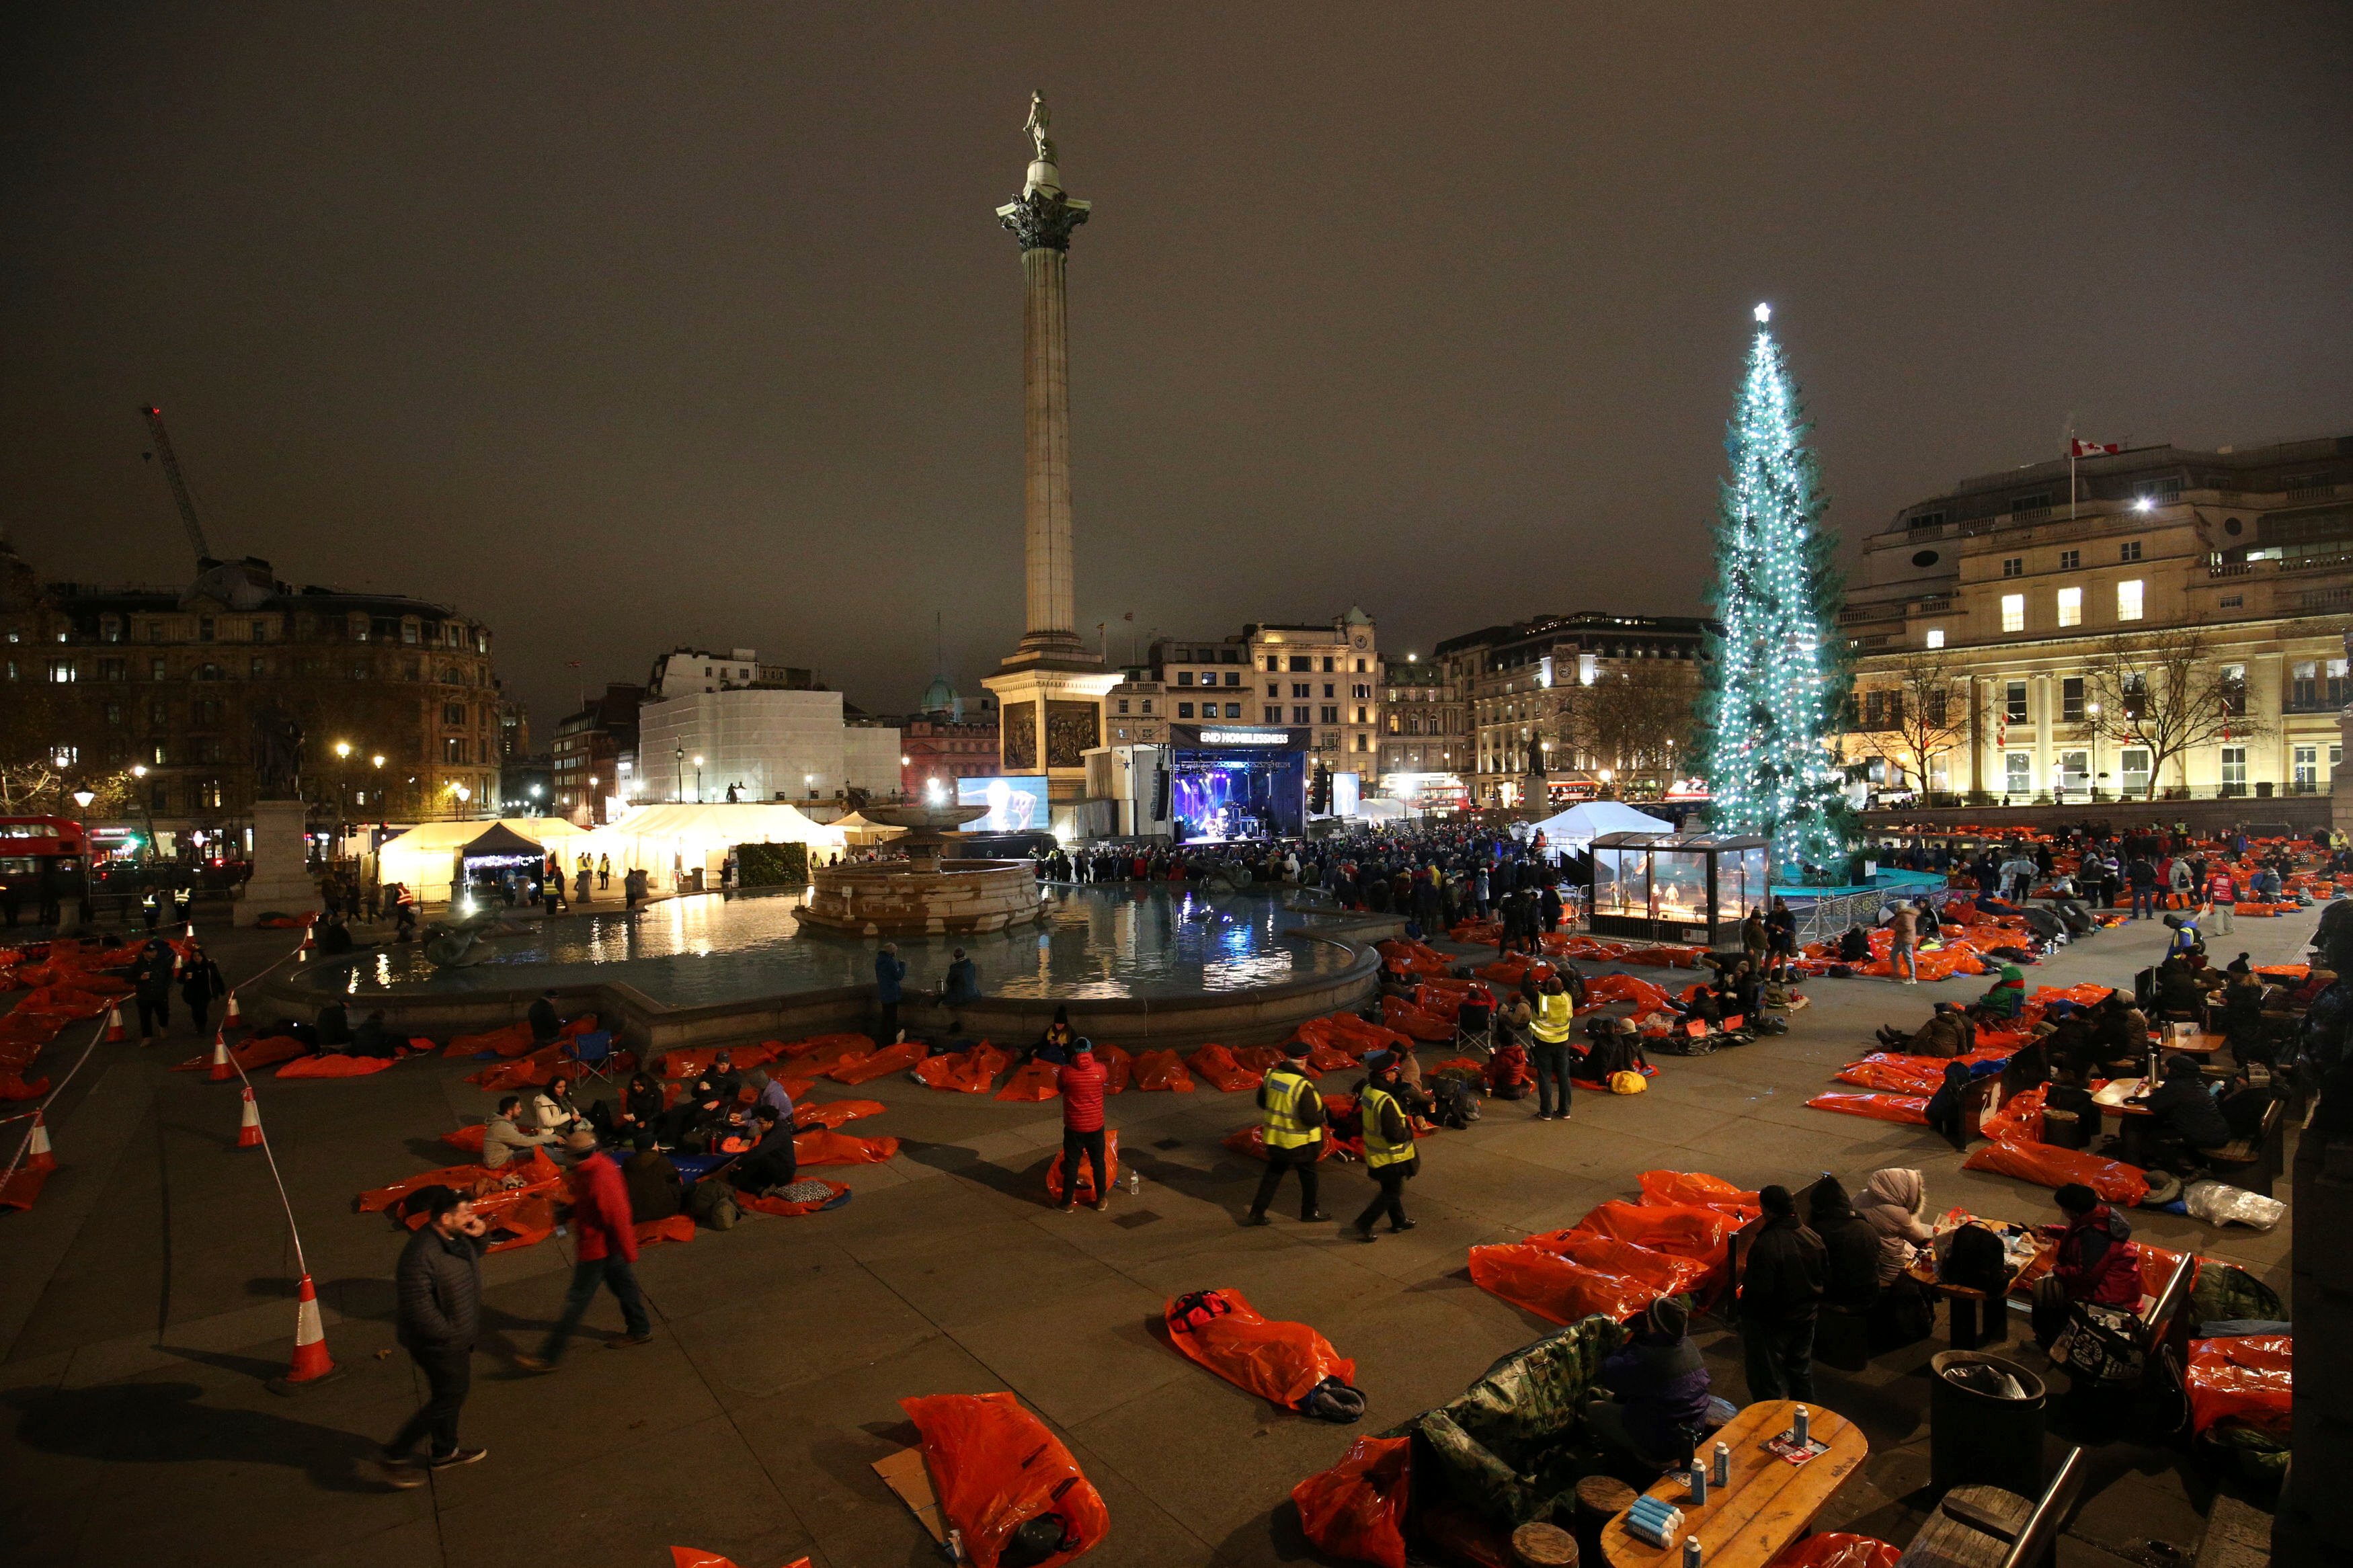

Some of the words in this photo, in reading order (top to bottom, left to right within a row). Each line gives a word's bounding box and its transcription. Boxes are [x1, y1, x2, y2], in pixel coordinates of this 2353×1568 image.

[1200, 732, 1221, 742] END
[1222, 733, 1289, 744] HOMELESSNESS
[1632, 1524, 1658, 1544] WATER
